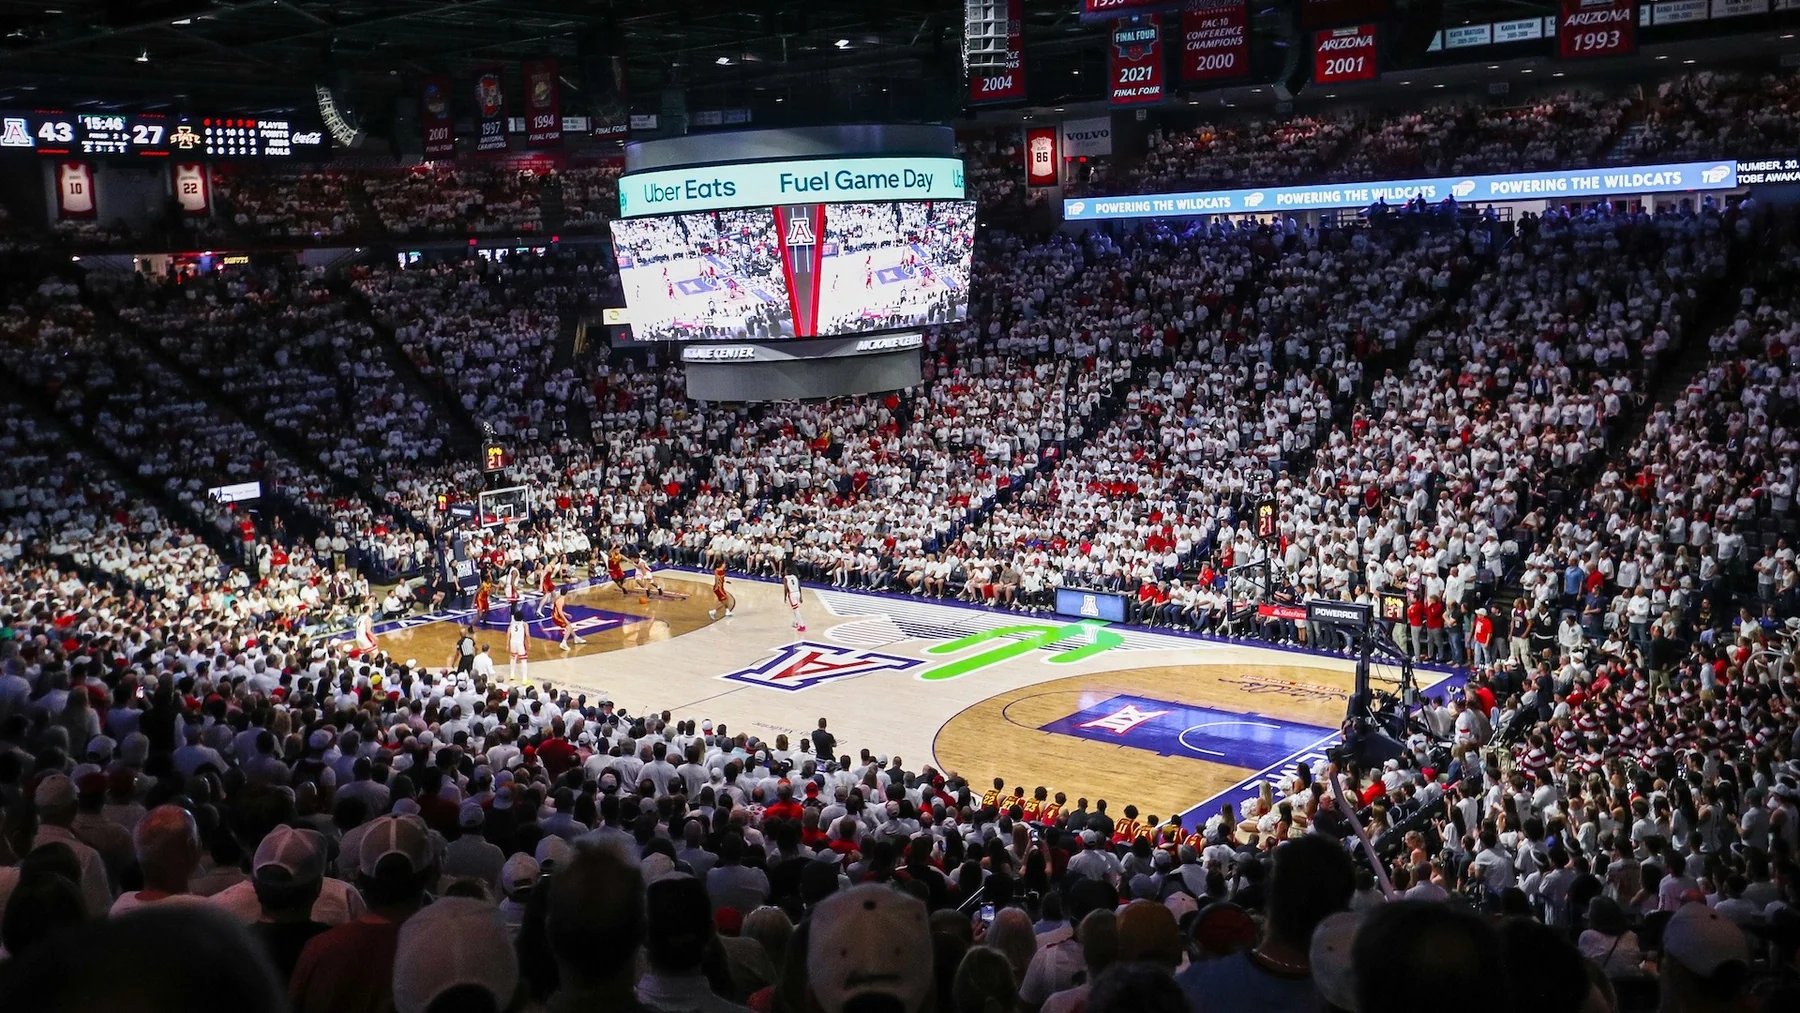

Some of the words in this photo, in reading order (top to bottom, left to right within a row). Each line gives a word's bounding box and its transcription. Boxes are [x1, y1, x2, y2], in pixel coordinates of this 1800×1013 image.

[1201, 18, 1229, 28] PAC-10
[1564, 8, 1630, 27] ARIZONA
[1116, 32, 1136, 42] FINAL
[1136, 28, 1156, 40] FOUR
[1186, 26, 1244, 40] CONFERENCE
[1186, 36, 1243, 50] CHAMPIONS
[1317, 35, 1373, 52] ARIZONA
[1574, 30, 1620, 51] 1993
[1196, 53, 1234, 71] 2000
[1324, 56, 1364, 75] 2001
[1119, 66, 1152, 82] 2021
[981, 75, 1012, 92] 2004
[1113, 88, 1136, 97] FINAL
[1138, 86, 1160, 94] FOUR
[84, 116, 124, 131] 15:46
[482, 121, 501, 135] 1997
[533, 114, 554, 129] 1994
[38, 122, 73, 142] 43
[133, 126, 163, 144] 27
[428, 128, 448, 141] 2001
[545, 132, 560, 140] FOUR
[595, 126, 612, 135] FINAL
[612, 124, 628, 132] FOUR
[1066, 130, 1109, 140] VOLVO
[477, 142, 506, 151] CHAMPIONS
[1036, 152, 1048, 162] 86
[1737, 160, 1783, 172] NUMBER,
[1785, 160, 1799, 169] 30.
[780, 172, 829, 193] Fuel
[835, 170, 900, 191] Game
[904, 169, 934, 192] Day
[1737, 174, 1764, 184] TOBE
[1765, 172, 1800, 182] AWAKA
[70, 183, 82, 194] 10
[184, 183, 198, 194] 22
[644, 184, 681, 203] Uber
[686, 178, 736, 200] Eats
[1095, 200, 1151, 214] POWERING
[1154, 198, 1174, 212] THE
[1176, 196, 1231, 210] WILDCATS
[1277, 190, 1341, 205] POWERING
[1344, 188, 1368, 202] THE
[1372, 184, 1436, 201] WILDCATS
[1490, 178, 1567, 194] POWERING
[1571, 176, 1599, 190] THE
[1604, 171, 1682, 188] WILDCATS
[714, 347, 755, 358] CENTER
[1315, 608, 1359, 620] POWERADE
[983, 795, 995, 805] 22
[1047, 810, 1055, 818] 4
[1117, 823, 1128, 834] 11
